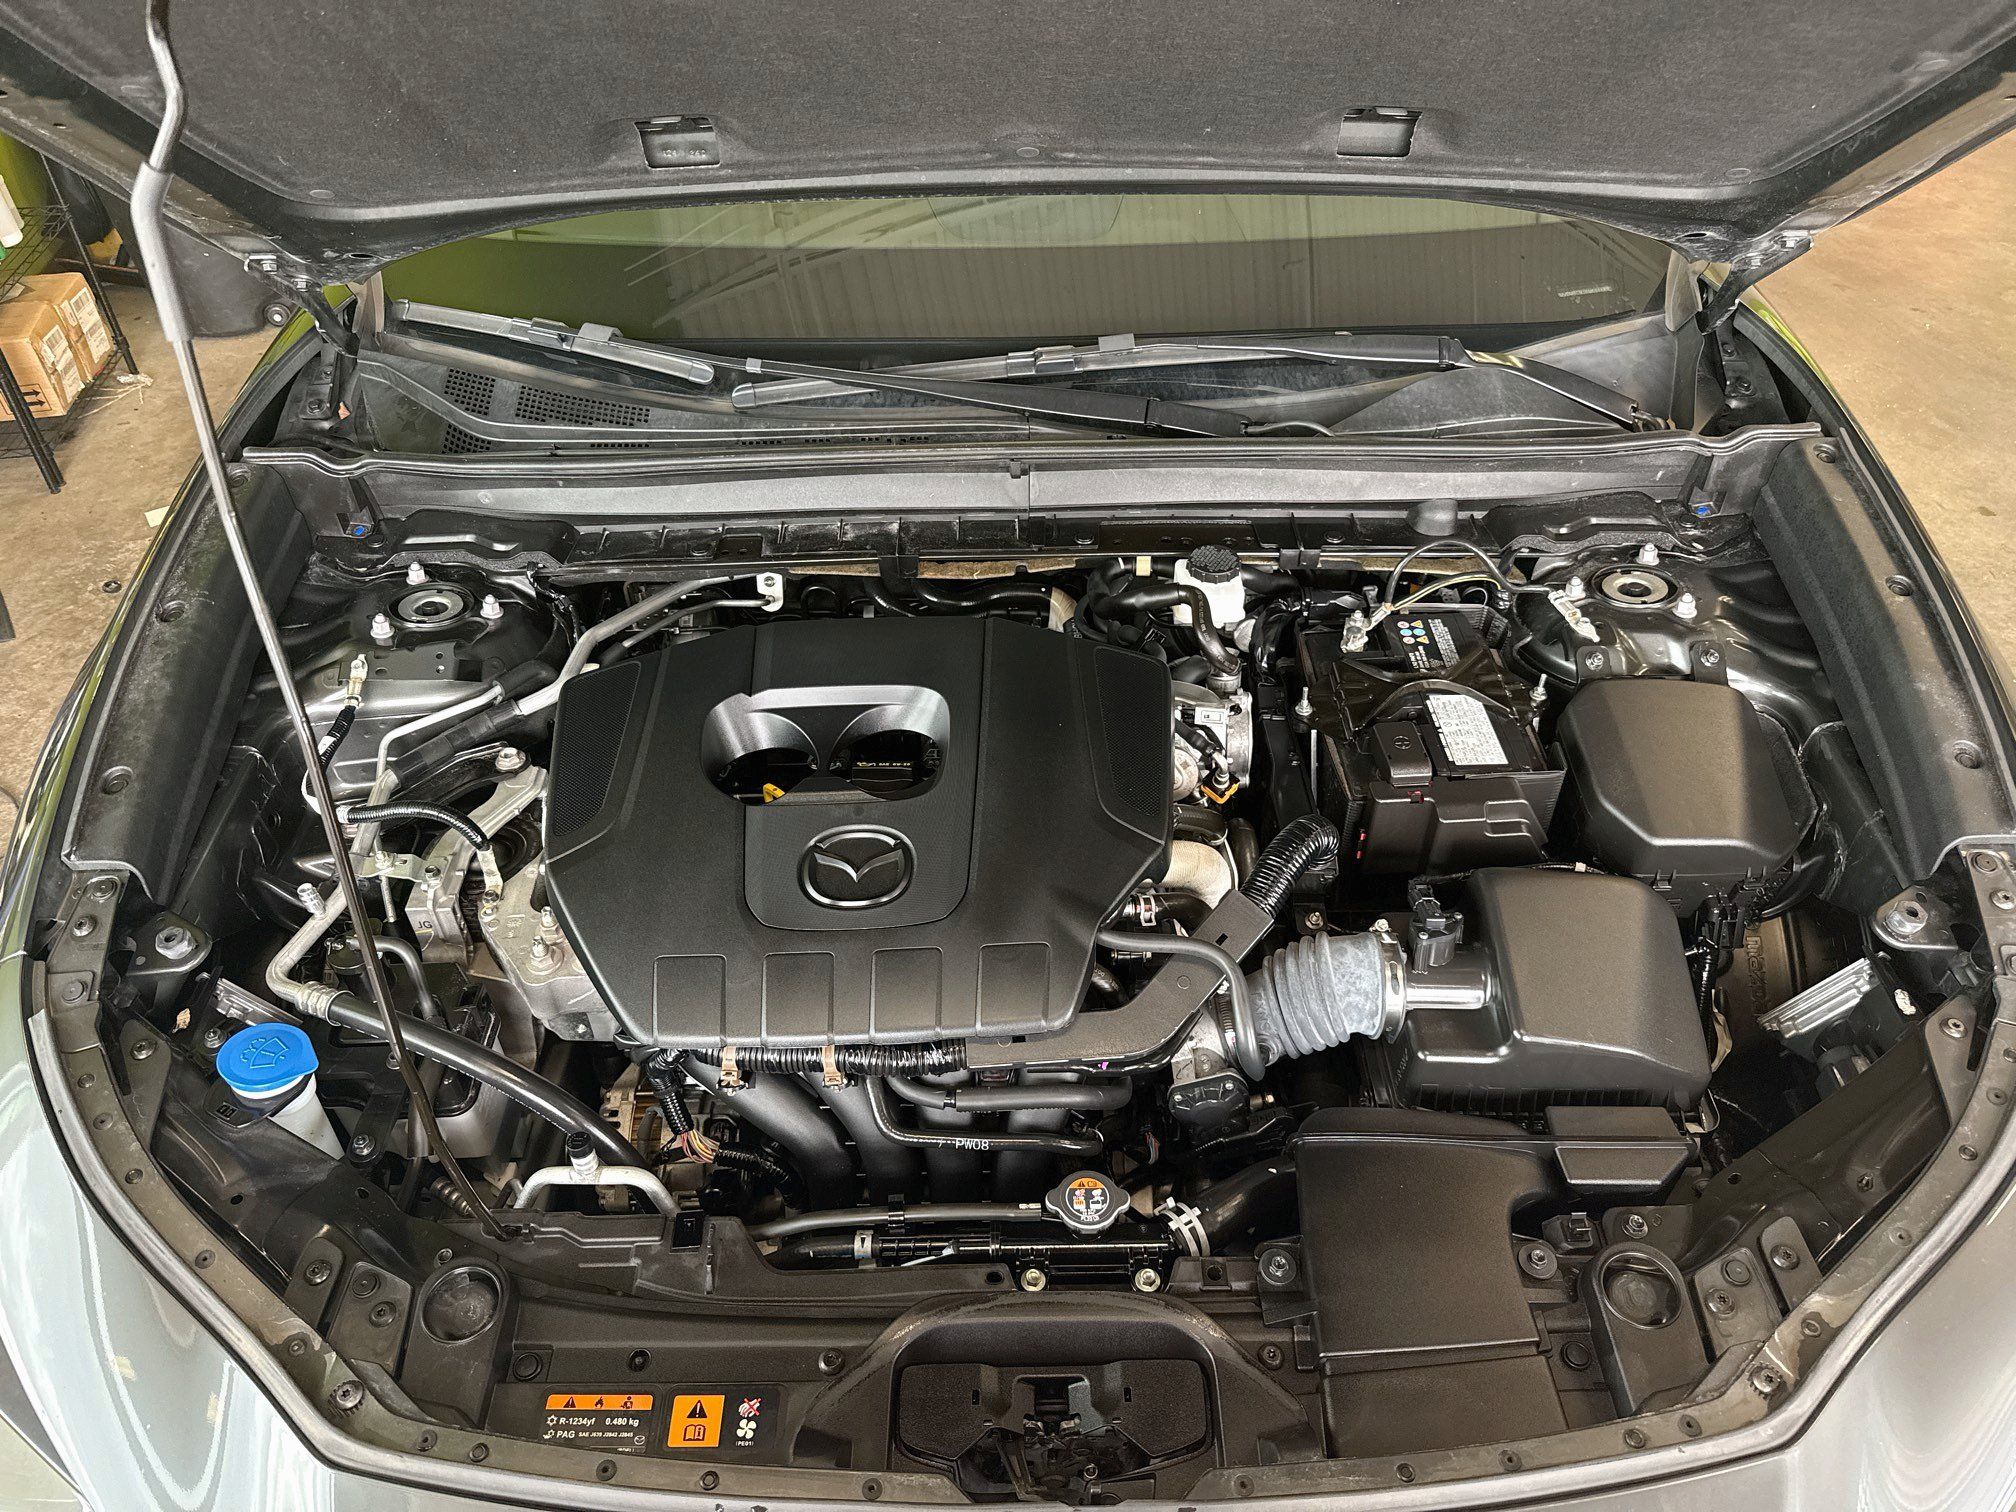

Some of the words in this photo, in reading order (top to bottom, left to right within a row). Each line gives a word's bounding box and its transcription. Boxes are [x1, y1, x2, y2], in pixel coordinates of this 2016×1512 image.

[417, 920, 433, 929] JG
[955, 1138, 990, 1151] PW08
[559, 1417, 596, 1427] R-1234yf
[605, 1417, 627, 1426] 0.480
[628, 1417, 640, 1427] kg
[556, 1430, 576, 1439] PAG
